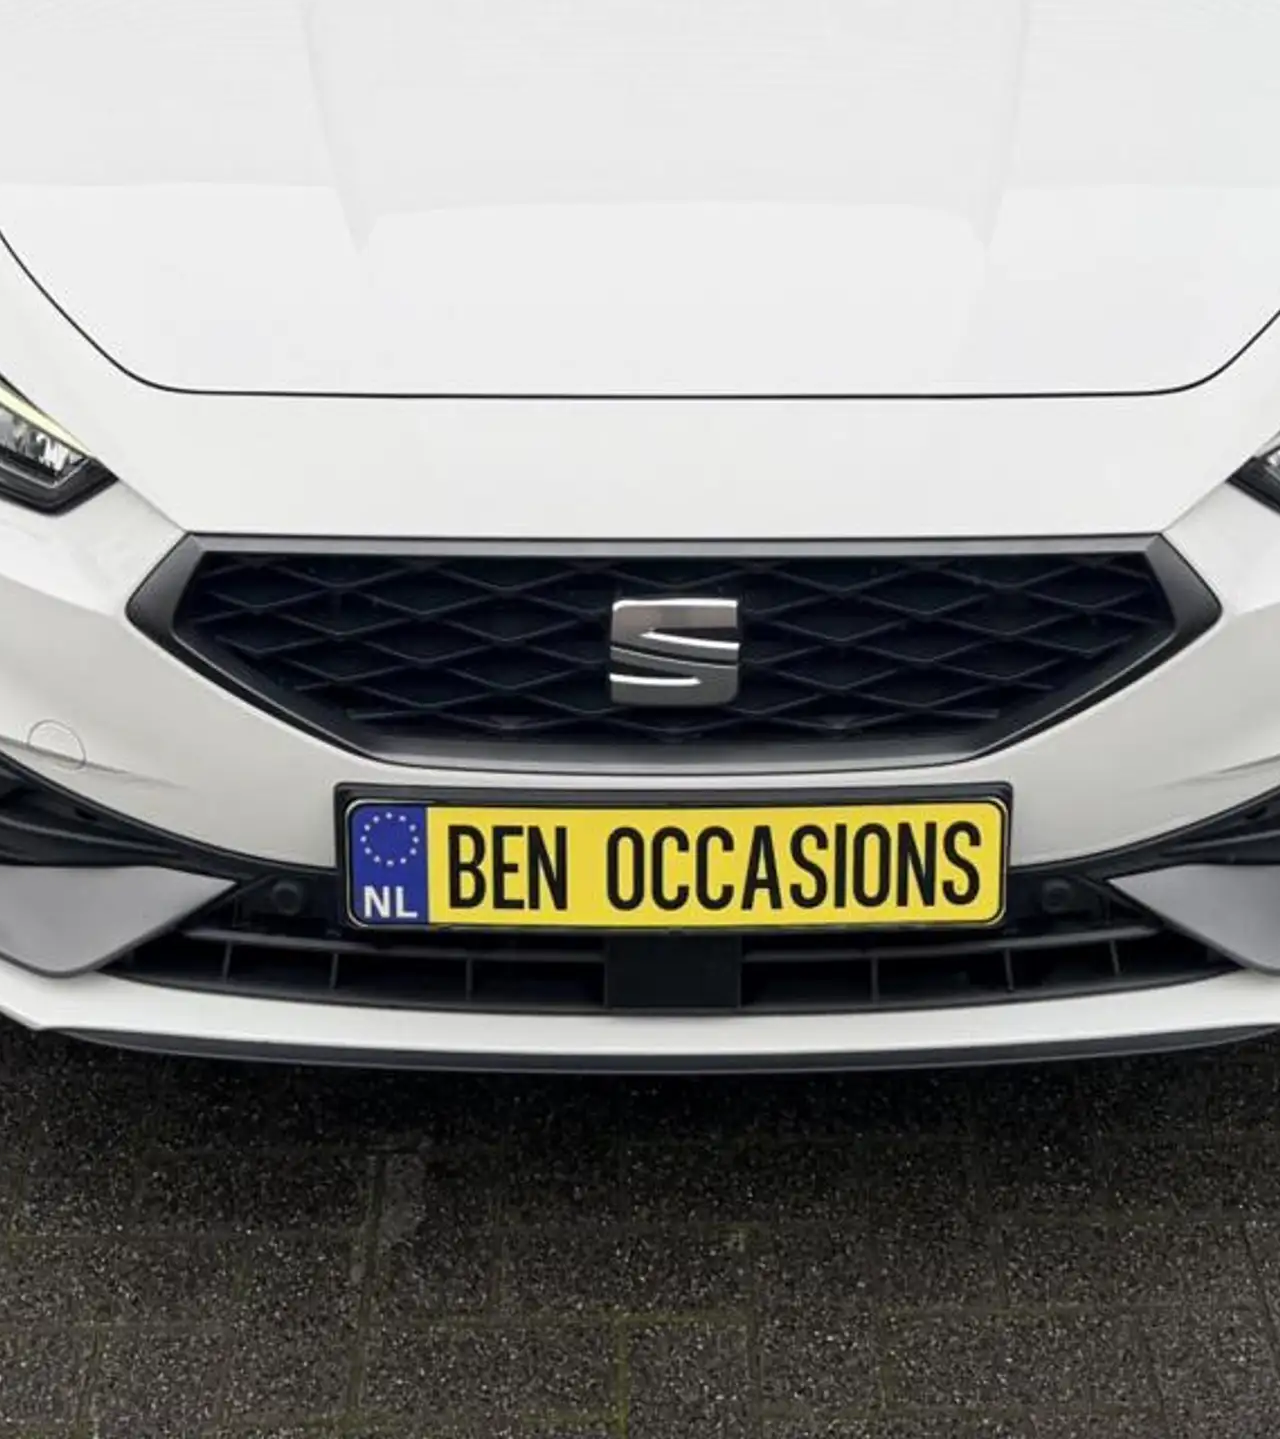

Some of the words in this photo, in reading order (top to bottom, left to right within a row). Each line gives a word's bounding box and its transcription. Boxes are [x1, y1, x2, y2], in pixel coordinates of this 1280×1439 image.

[364, 886, 418, 918] NL
[448, 824, 568, 911] BEN
[606, 821, 981, 911] OCCASIONS
